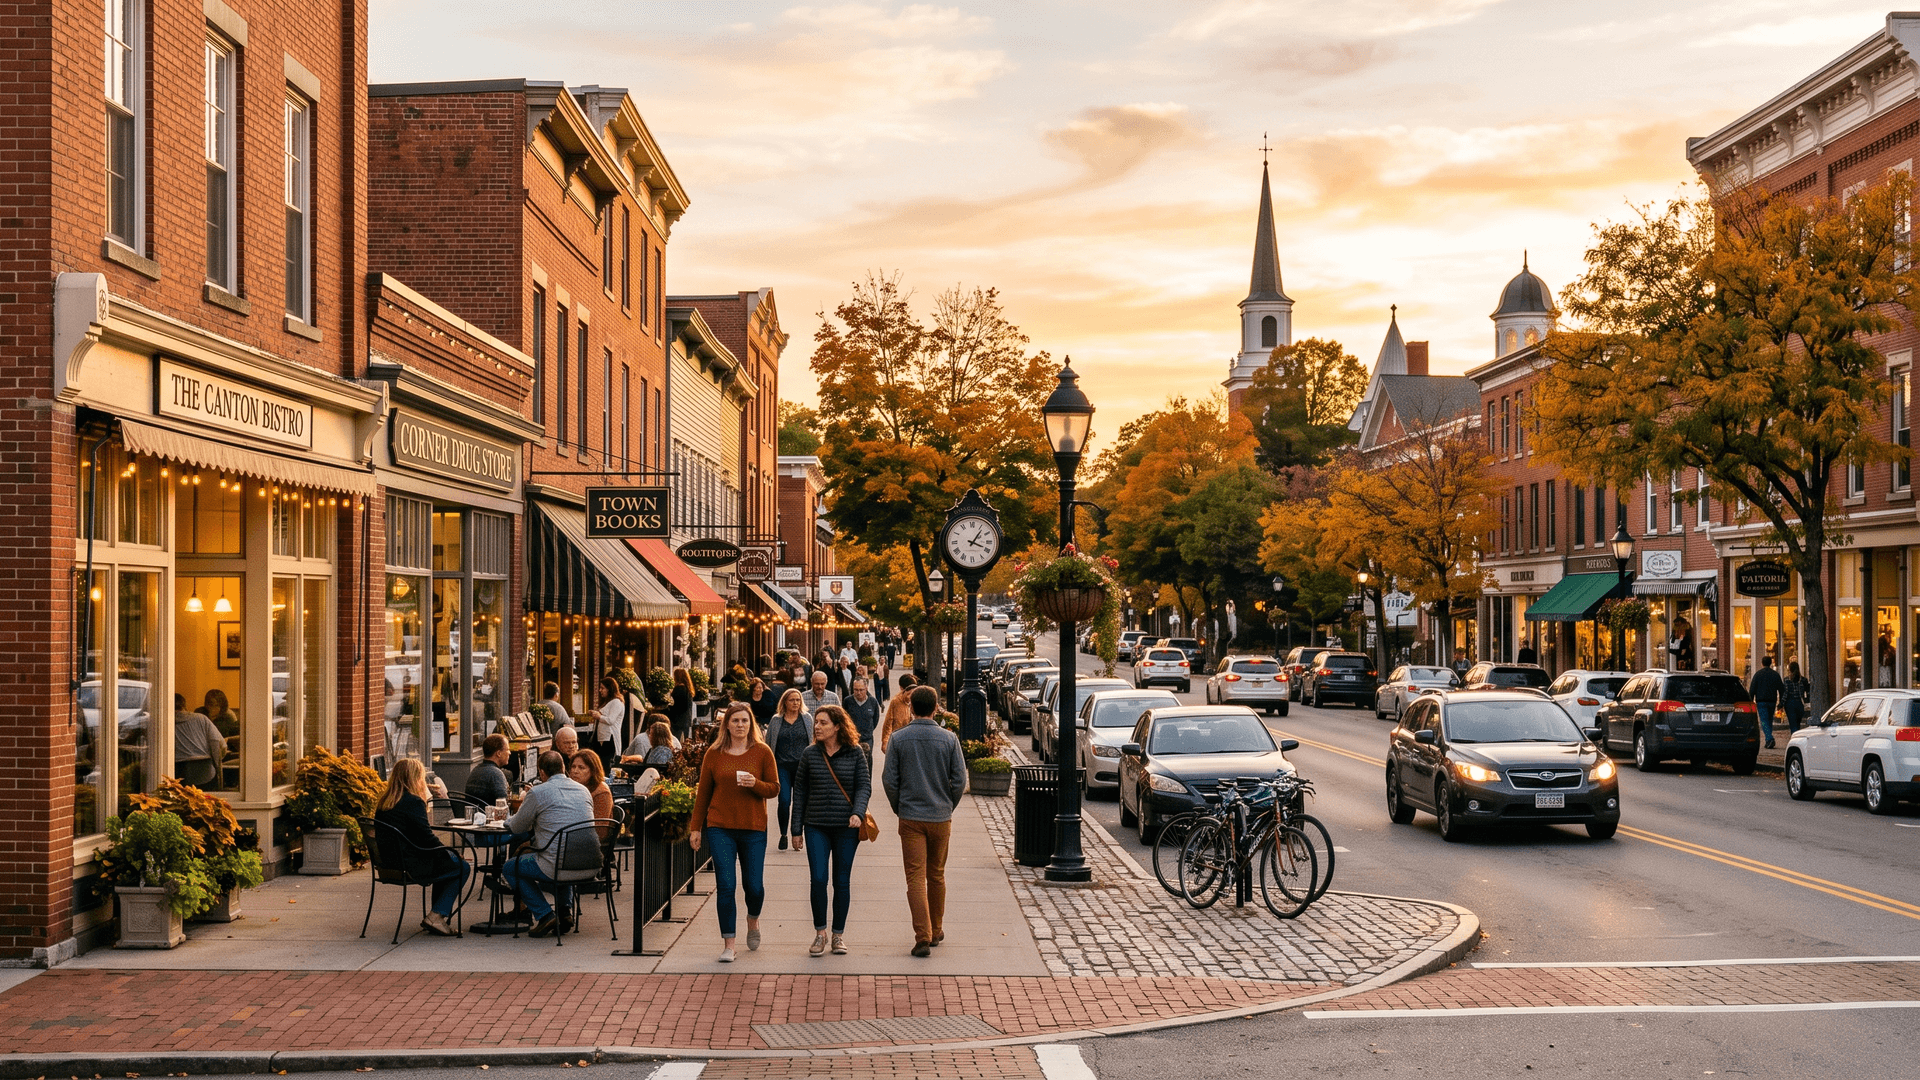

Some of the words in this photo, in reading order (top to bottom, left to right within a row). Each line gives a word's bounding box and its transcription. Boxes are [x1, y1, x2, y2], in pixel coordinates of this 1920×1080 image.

[171, 373, 201, 411] THE
[204, 383, 259, 426] CANTON
[262, 400, 304, 437] BISTRO
[400, 422, 449, 466] CORNER
[451, 438, 480, 474] DRUG
[482, 448, 512, 483] STORE
[595, 514, 662, 529] BOOKS
[598, 496, 658, 512] TOWN
